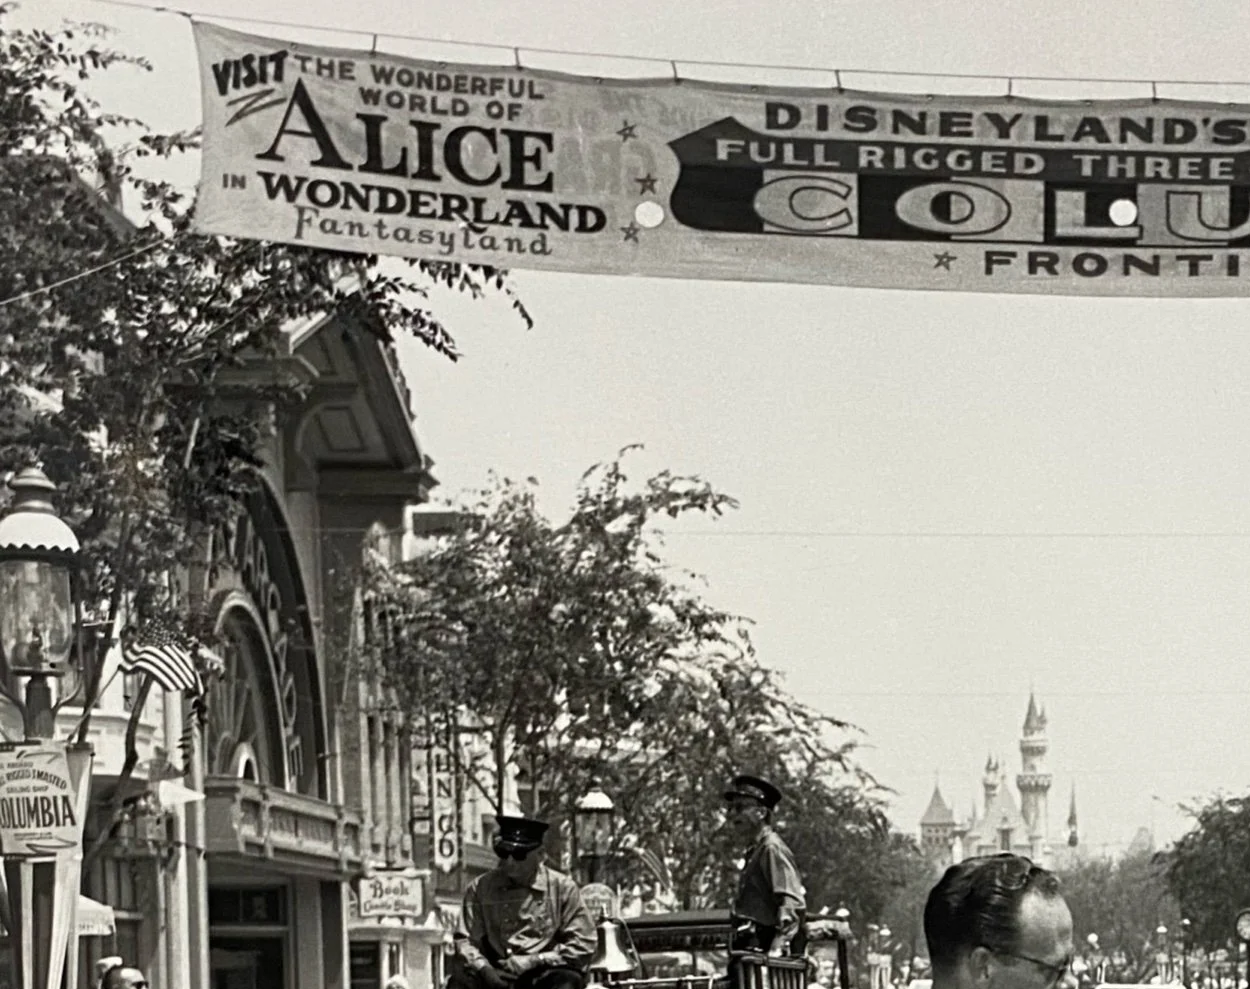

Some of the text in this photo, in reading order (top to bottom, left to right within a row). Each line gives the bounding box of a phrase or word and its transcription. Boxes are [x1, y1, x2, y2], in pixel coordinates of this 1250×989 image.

[212, 49, 289, 97] VISIT
[296, 53, 546, 101] THE WONDERFUL
[358, 86, 523, 122] WORLD OF
[765, 101, 1248, 146] DISNEYLAND'S
[255, 77, 555, 193] ALICE
[715, 139, 841, 169] FULL
[858, 147, 1047, 177] RIGGED
[222, 171, 607, 235] IN WONDERLAND
[294, 206, 553, 257] Fantasyland
[0, 795, 77, 829] OLUMBIA
[369, 880, 410, 900] Book
